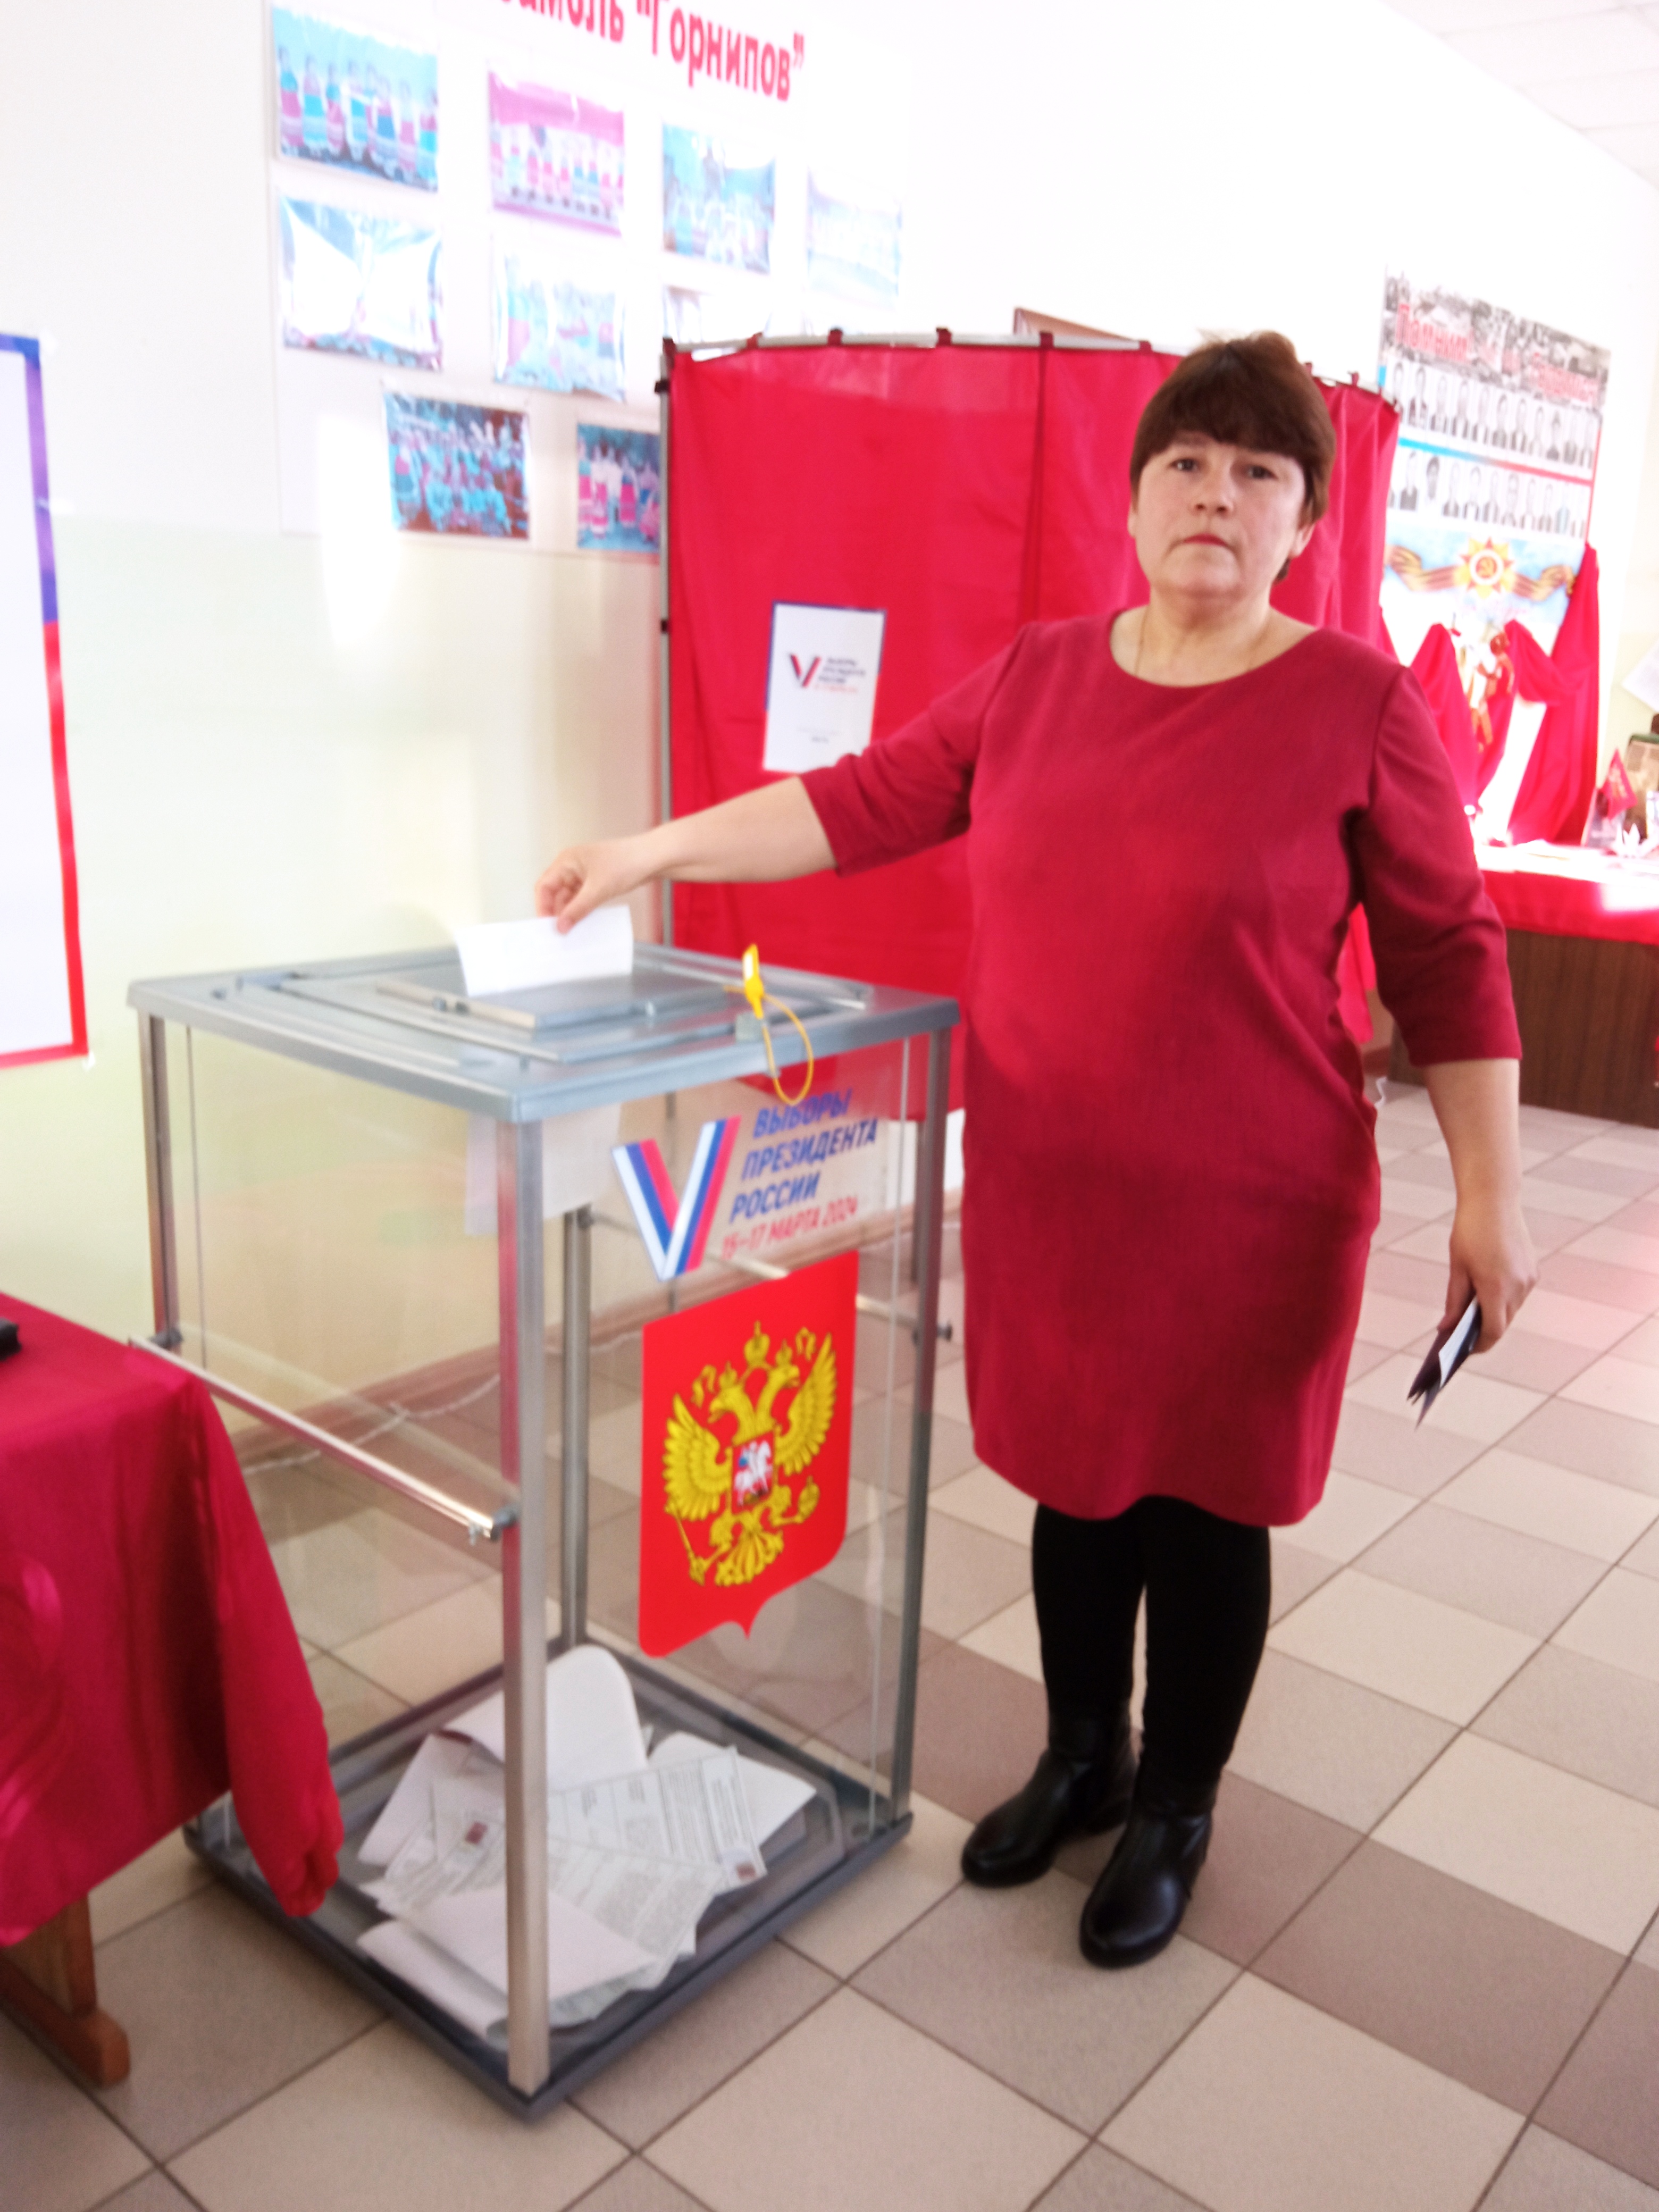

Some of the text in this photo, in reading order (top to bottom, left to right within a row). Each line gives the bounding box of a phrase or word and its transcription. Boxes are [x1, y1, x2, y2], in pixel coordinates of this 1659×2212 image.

[753, 1088, 853, 1139] ВЫБОРЫ
[741, 1117, 878, 1182] ПРЕЗИДЕНТА
[728, 1171, 821, 1225] РОССИИ
[768, 1207, 820, 1243] МАРТА
[823, 1196, 858, 1228] 2024
